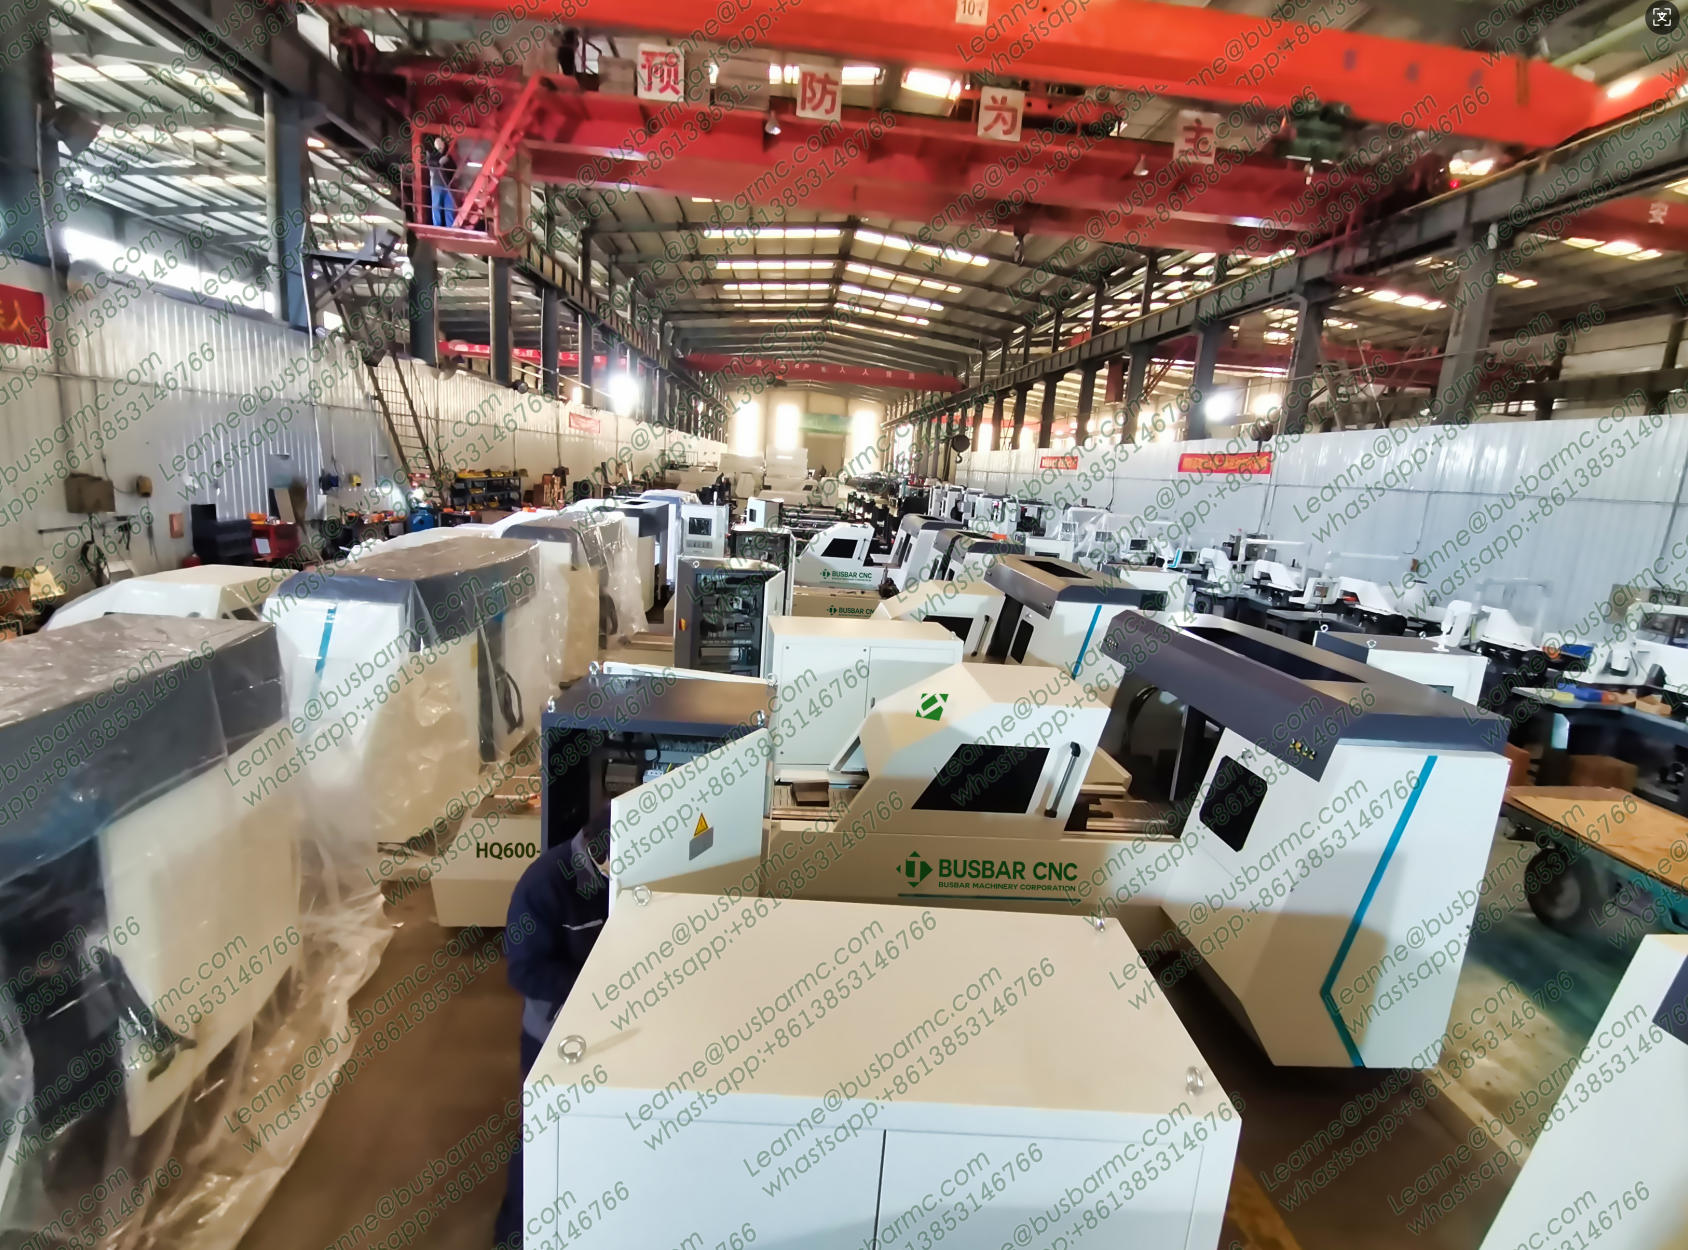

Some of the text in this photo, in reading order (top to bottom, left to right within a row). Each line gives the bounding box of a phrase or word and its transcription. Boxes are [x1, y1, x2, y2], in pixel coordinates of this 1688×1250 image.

[801, 71, 839, 116] 防
[983, 94, 1019, 136] 为
[831, 570, 873, 579] BUSBAR CNC
[838, 606, 865, 615] BUSBAR
[938, 858, 1078, 882] BUSBAR CNC
[938, 881, 1076, 893] BUSBAR MACHINERY CORPORATION
